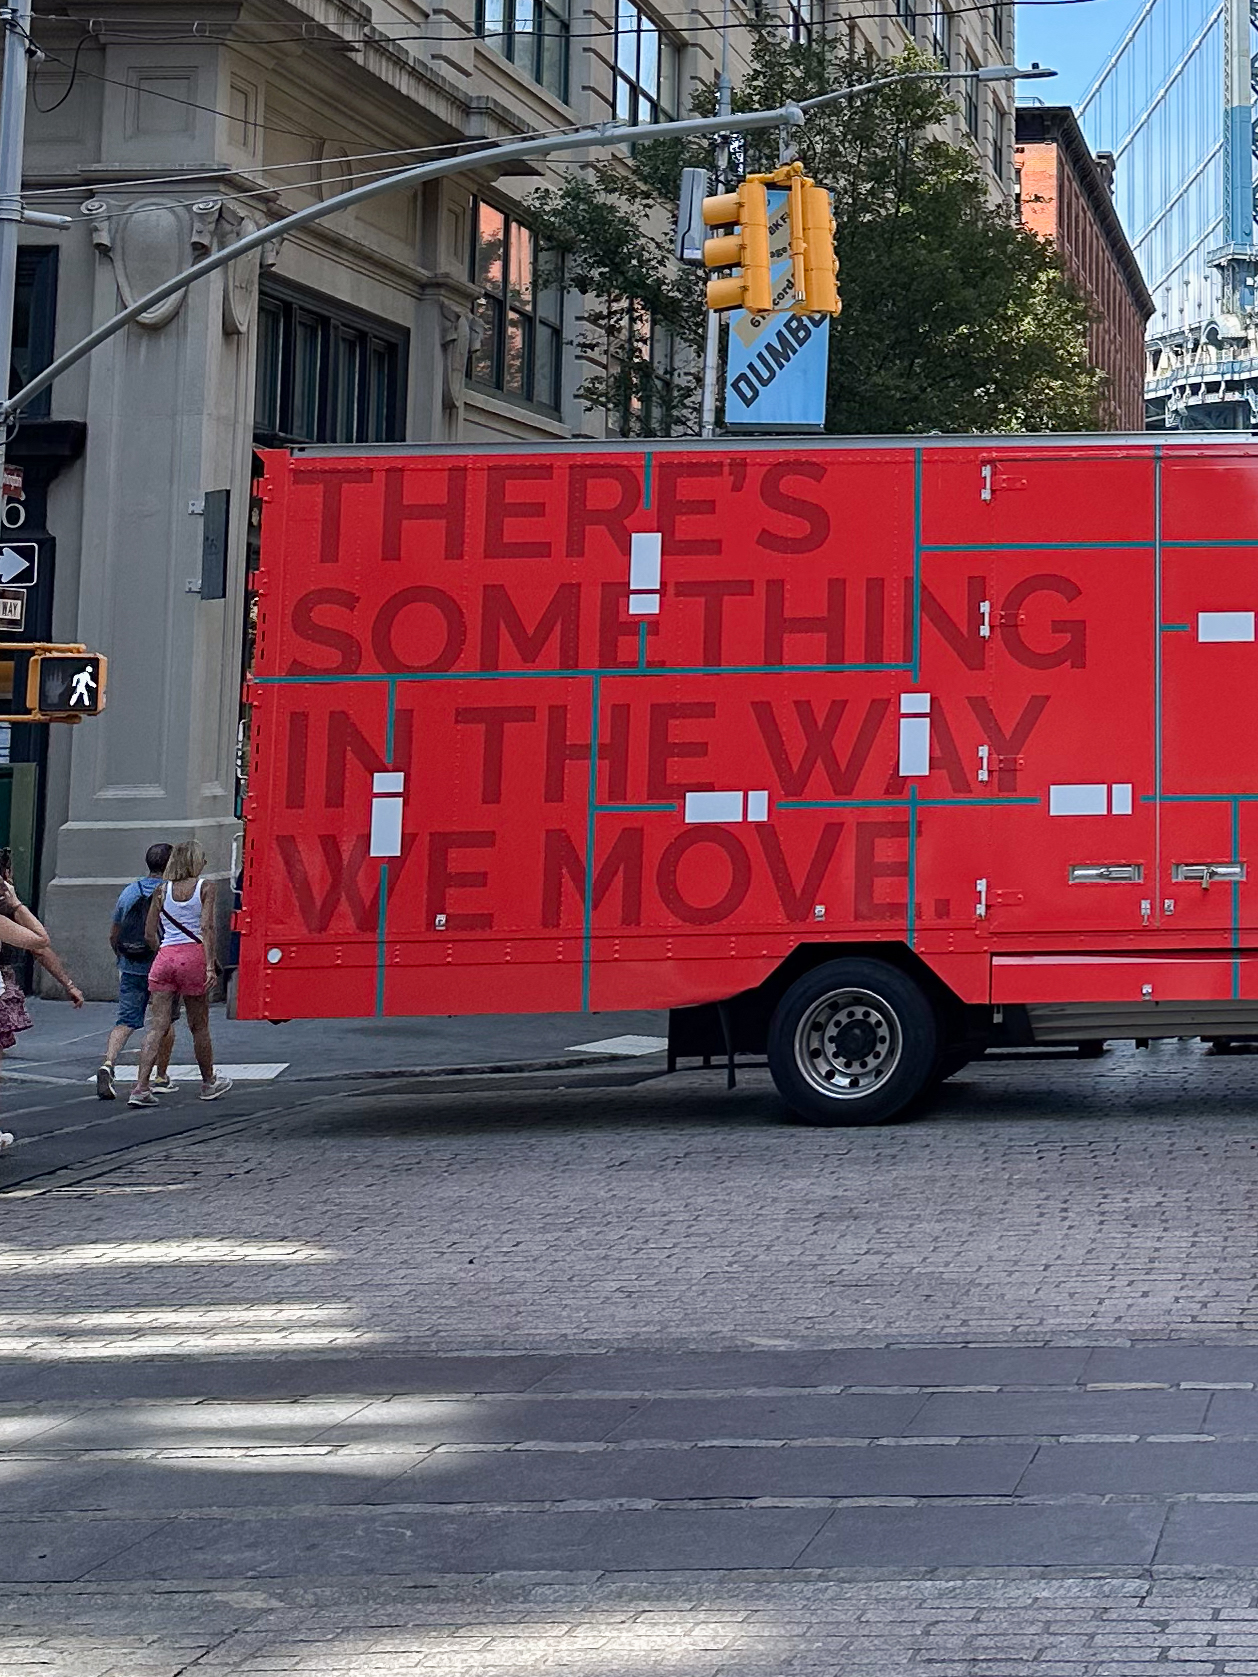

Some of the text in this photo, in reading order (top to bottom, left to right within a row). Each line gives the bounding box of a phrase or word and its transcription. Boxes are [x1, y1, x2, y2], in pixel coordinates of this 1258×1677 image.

[294, 458, 831, 564] THERE'S
[286, 574, 1087, 675] SOMETHING
[285, 695, 1050, 810] IN THE WAY
[276, 820, 950, 934] WE MOVE.
